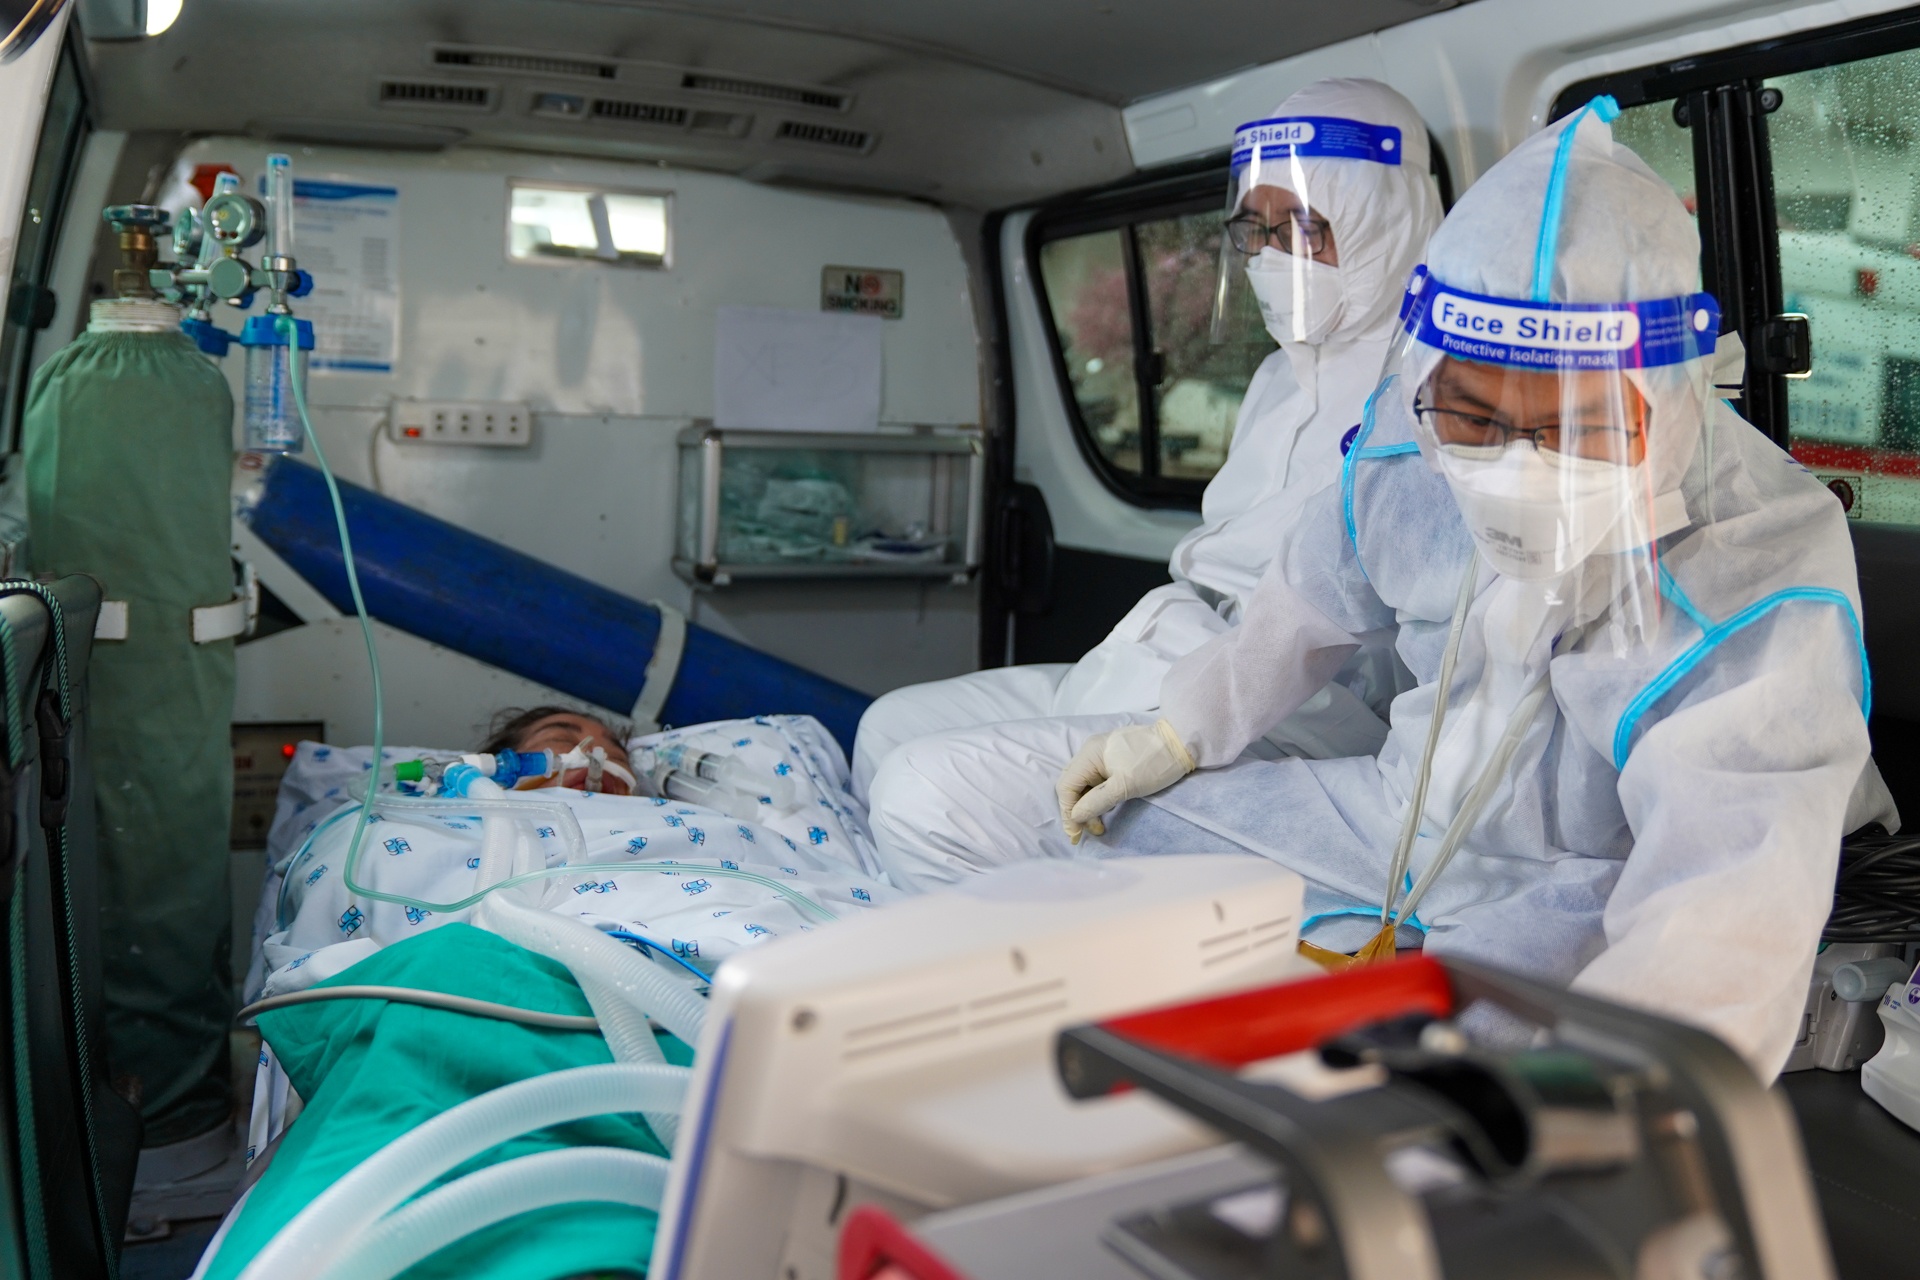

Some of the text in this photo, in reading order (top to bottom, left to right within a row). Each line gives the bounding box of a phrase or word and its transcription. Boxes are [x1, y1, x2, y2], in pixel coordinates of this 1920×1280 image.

[1250, 126, 1301, 143] Shield
[826, 295, 898, 313] SMOKING
[1442, 302, 1623, 343] Face Shield
[1442, 333, 1615, 366] Protective isolation mask
